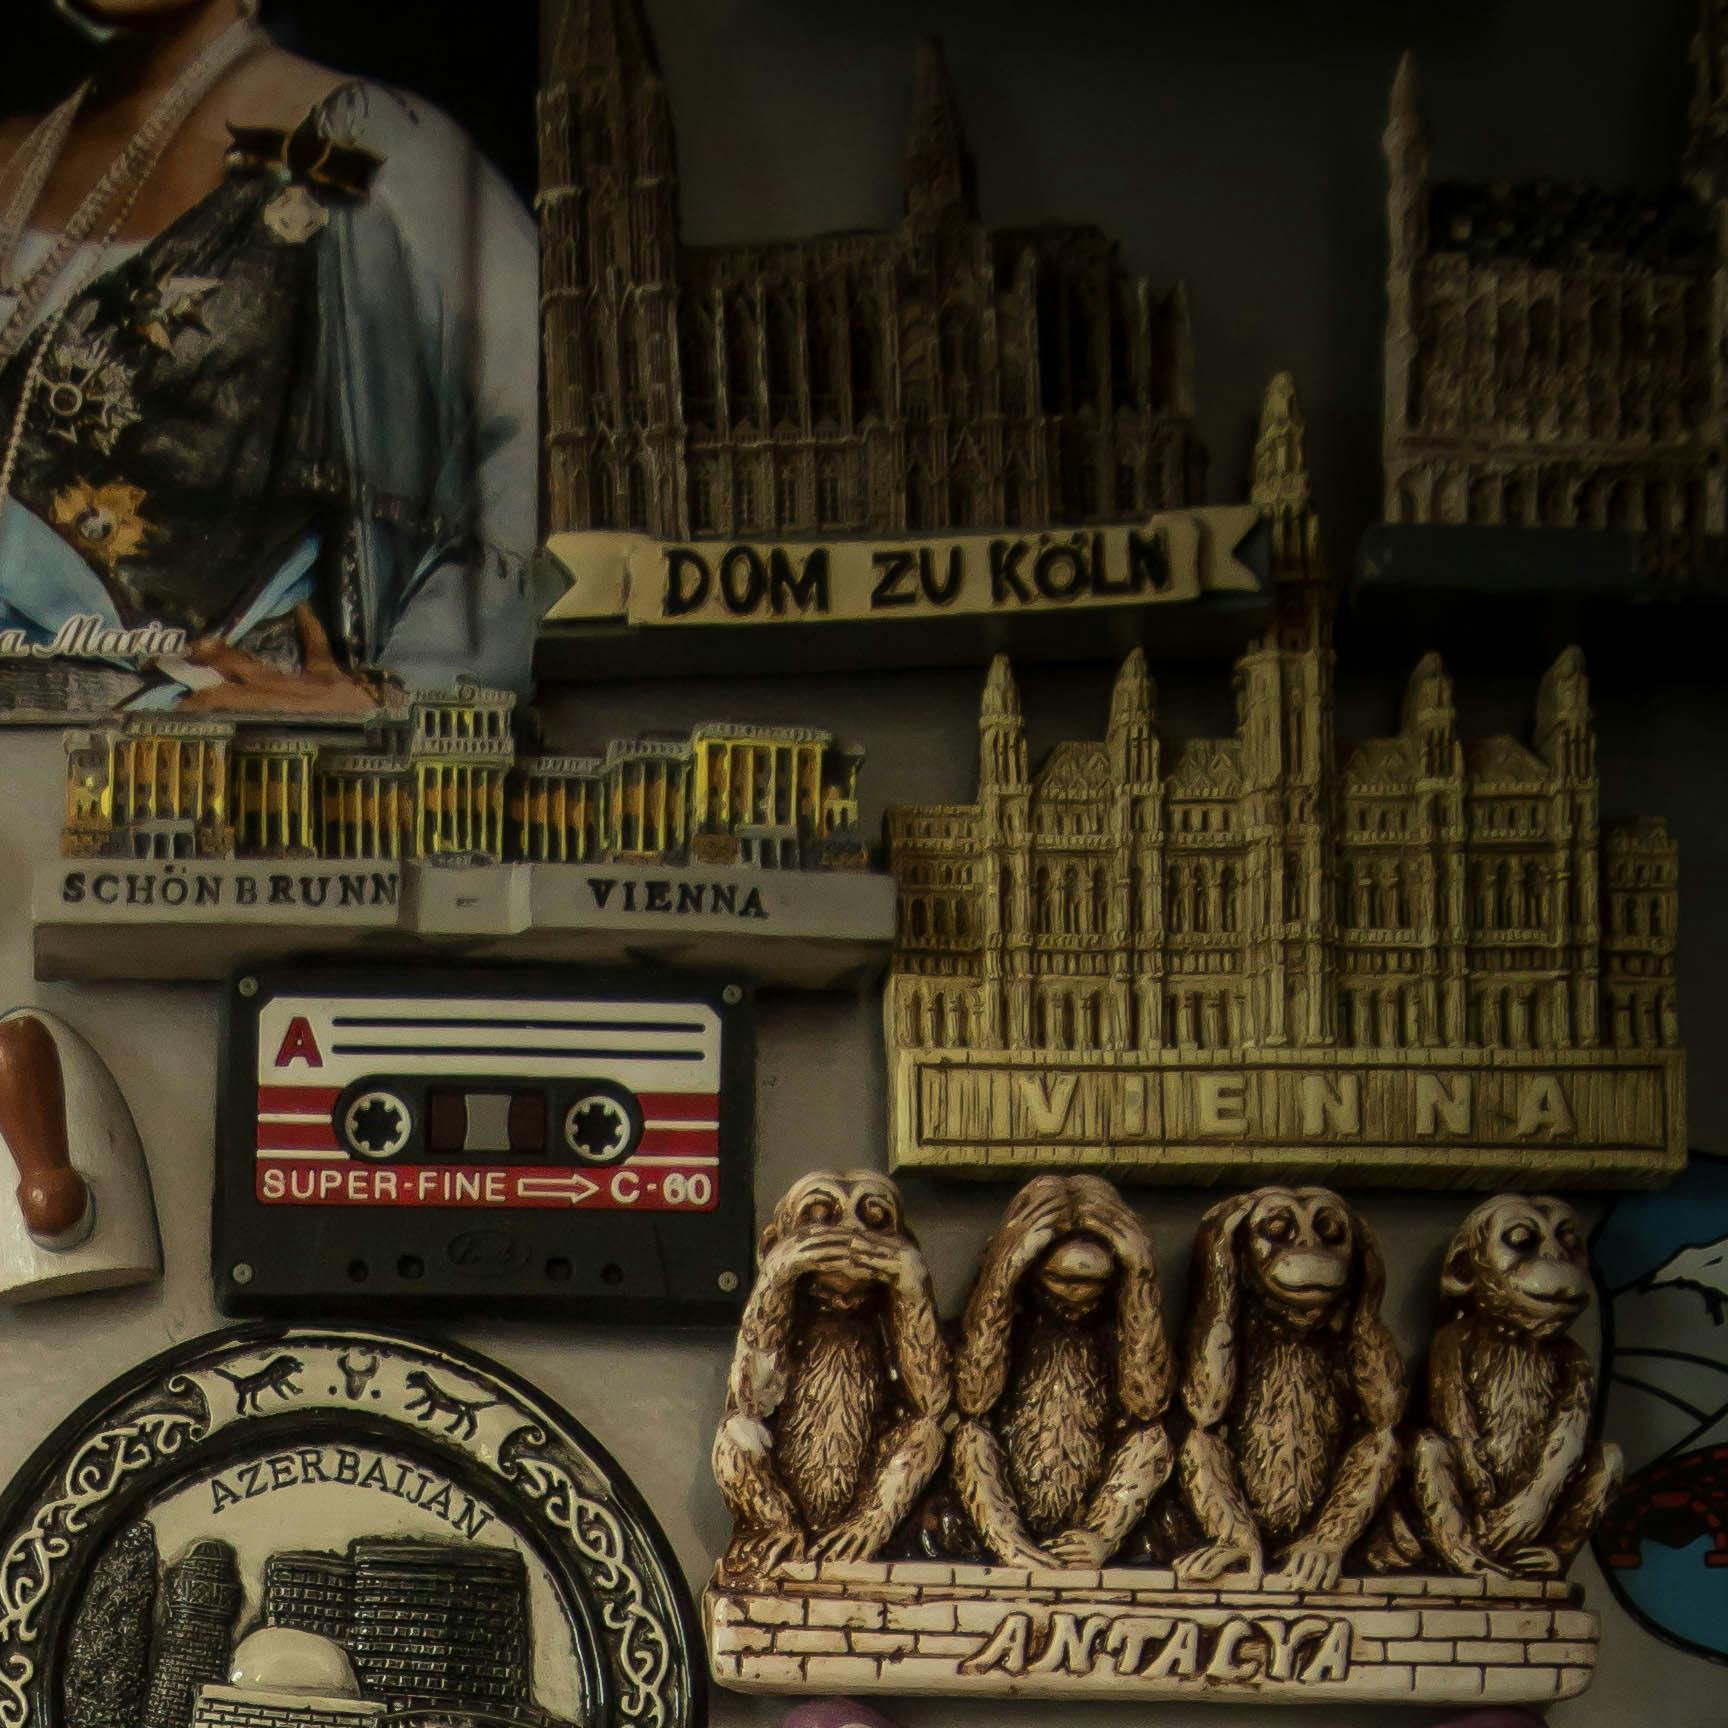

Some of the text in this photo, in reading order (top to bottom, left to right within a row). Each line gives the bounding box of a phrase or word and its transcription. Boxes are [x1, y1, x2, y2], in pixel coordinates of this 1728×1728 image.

[662, 528, 1170, 618] DOM ZU KÖLN
[586, 877, 770, 920] VIENNA
[274, 1015, 324, 1069] A
[1018, 1073, 1580, 1139] VIENNA
[261, 1168, 508, 1203] SUPER-FINE
[208, 1447, 495, 1541] AZERBAIJAN
[957, 1611, 1355, 1685] ANTALYA
